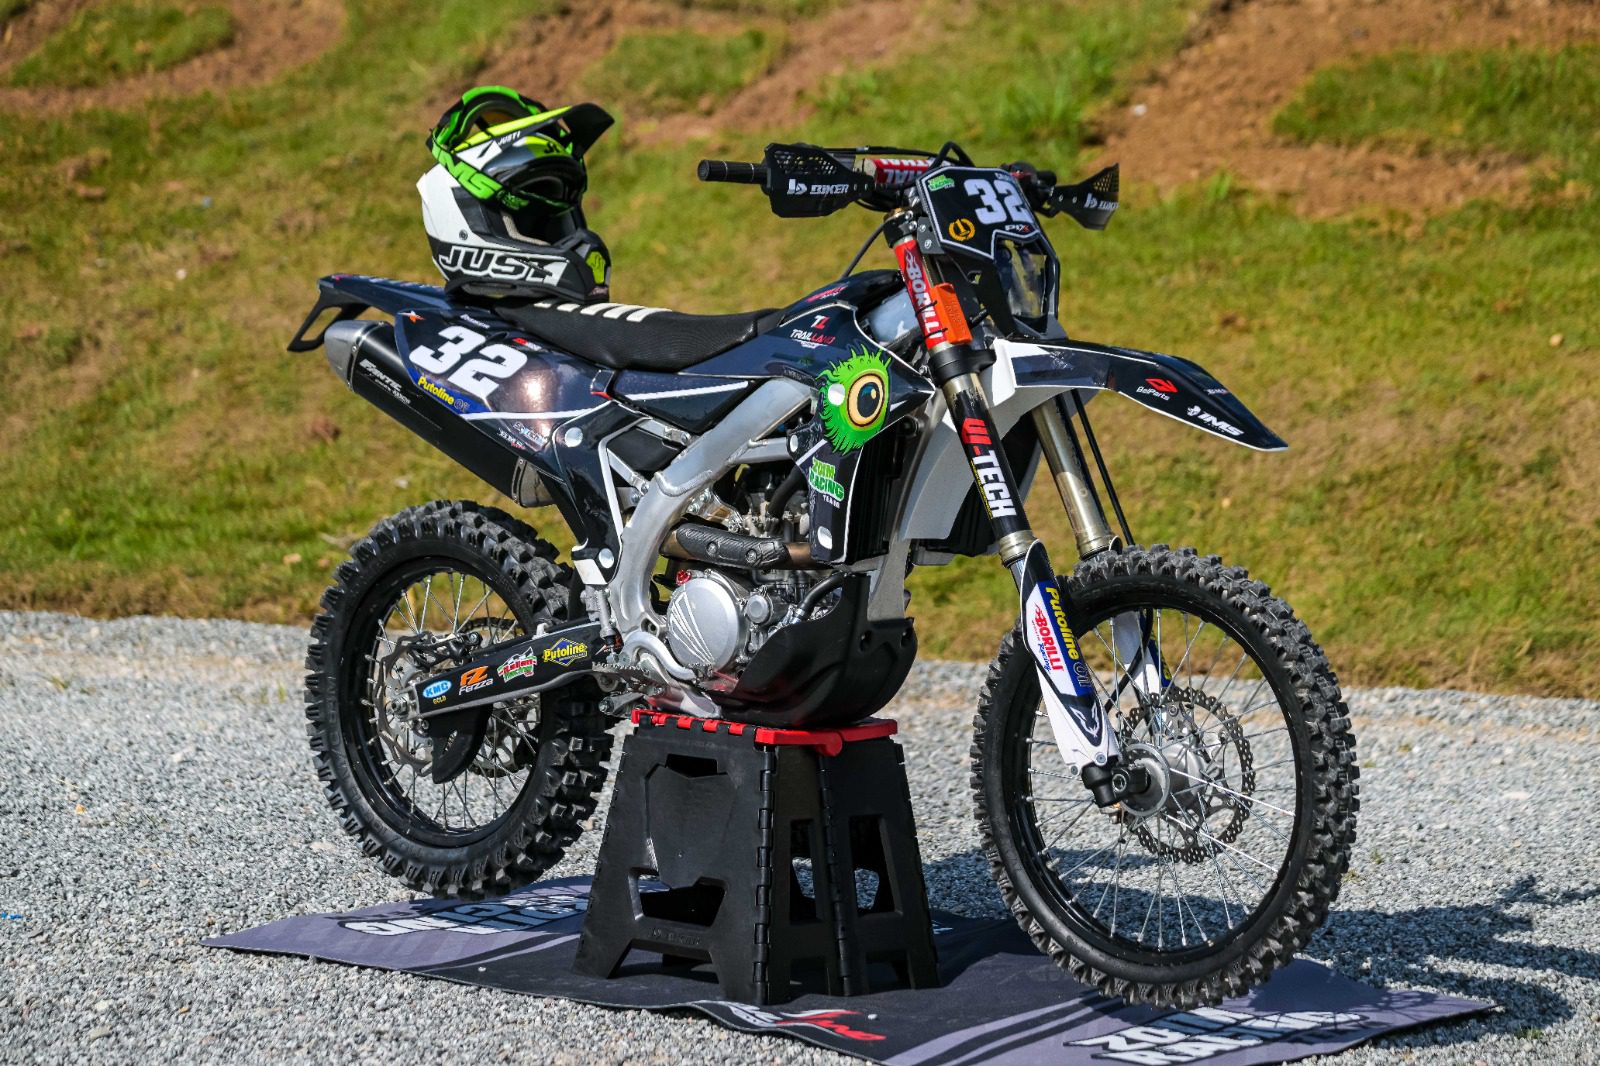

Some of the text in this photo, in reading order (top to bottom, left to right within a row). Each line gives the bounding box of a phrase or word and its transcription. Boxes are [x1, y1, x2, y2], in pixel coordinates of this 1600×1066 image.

[964, 178, 1034, 225] 32
[409, 325, 528, 400] 32
[418, 376, 454, 405] Putoline
[809, 467, 845, 502] RACING
[1035, 606, 1065, 671] BORILLI
[1045, 587, 1080, 660] Putoline
[543, 642, 586, 662] Putoline
[426, 682, 449, 697] KMC
